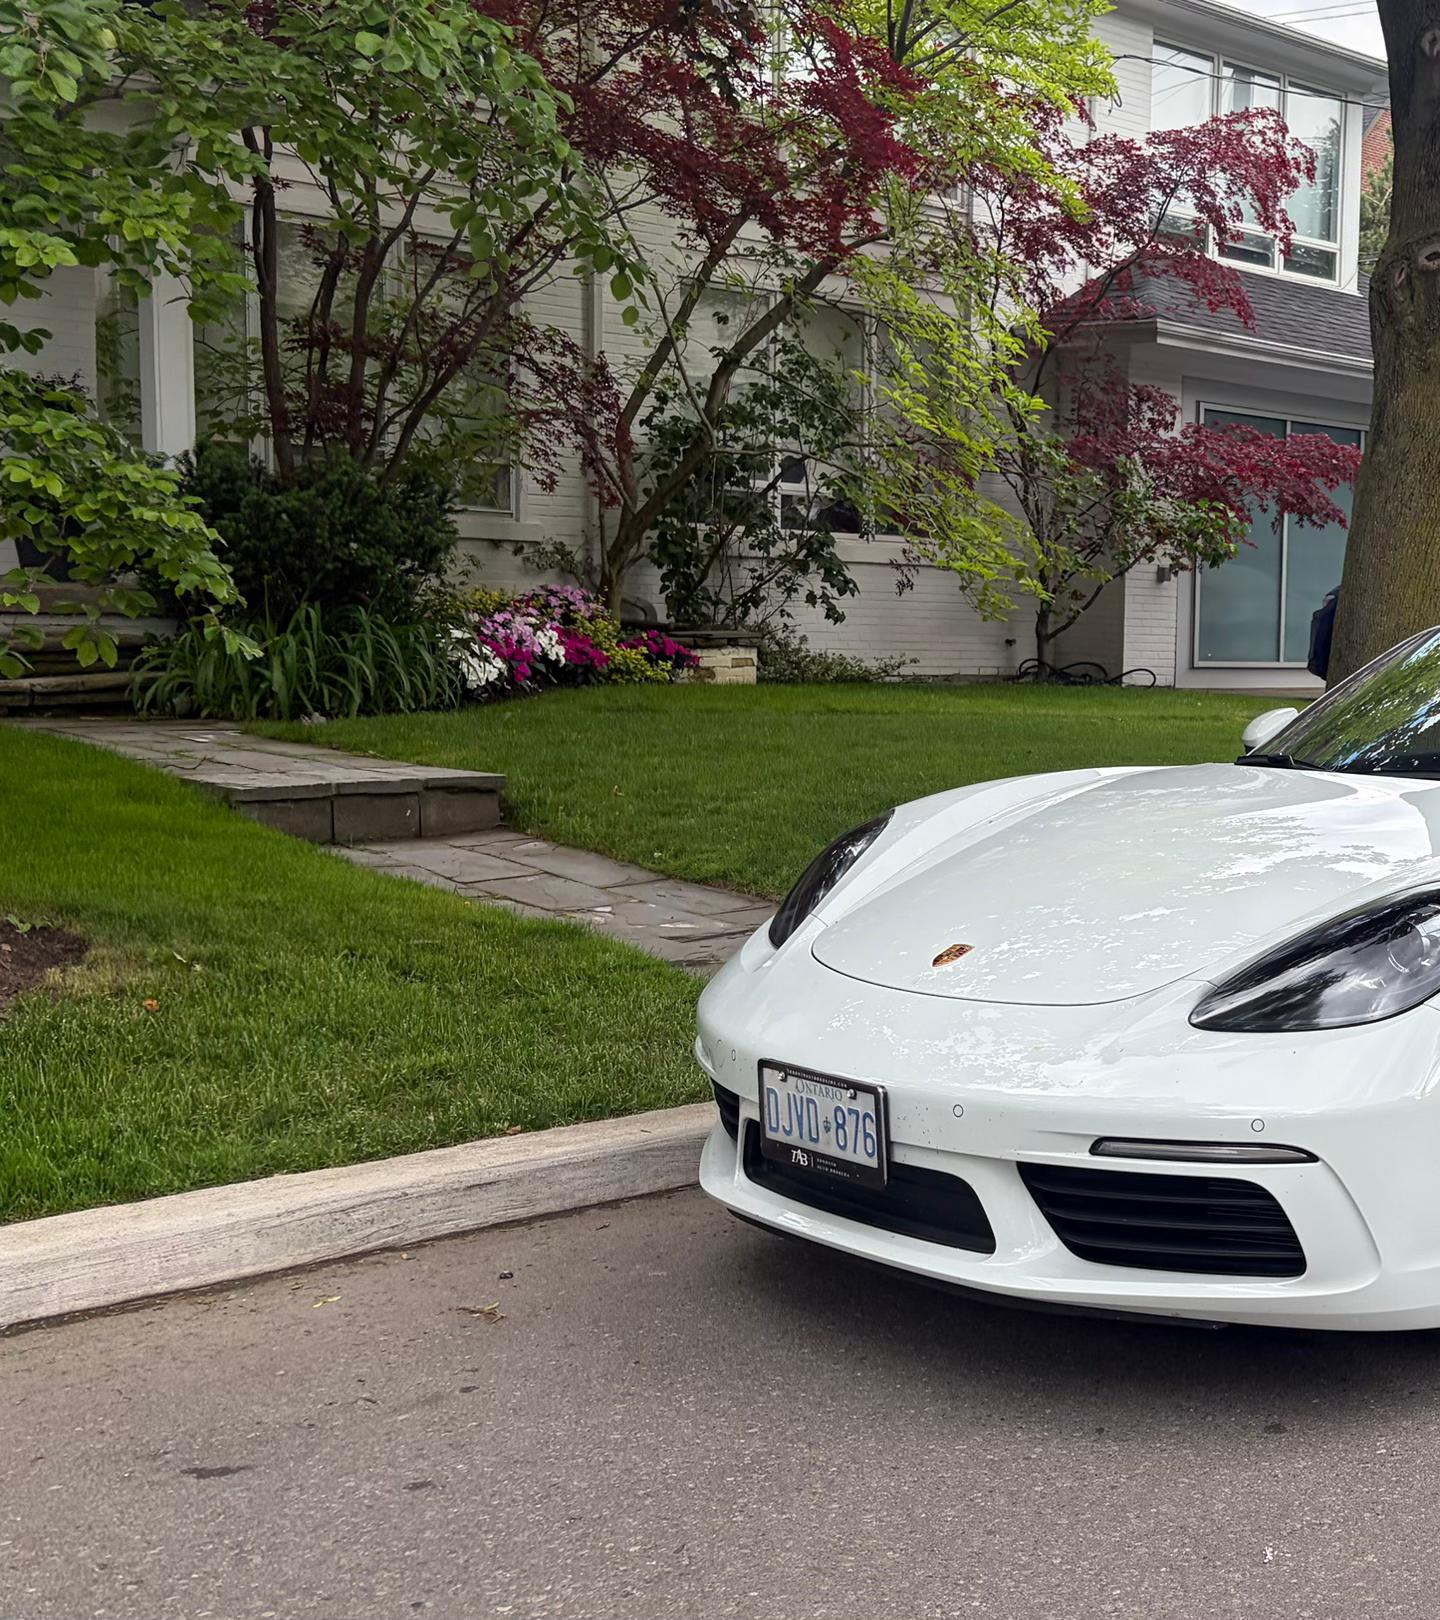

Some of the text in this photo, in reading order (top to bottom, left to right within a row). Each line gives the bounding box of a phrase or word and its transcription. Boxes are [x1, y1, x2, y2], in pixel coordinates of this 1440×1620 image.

[795, 1079, 843, 1101] ONTARIO
[766, 1087, 876, 1158] DJVD 876
